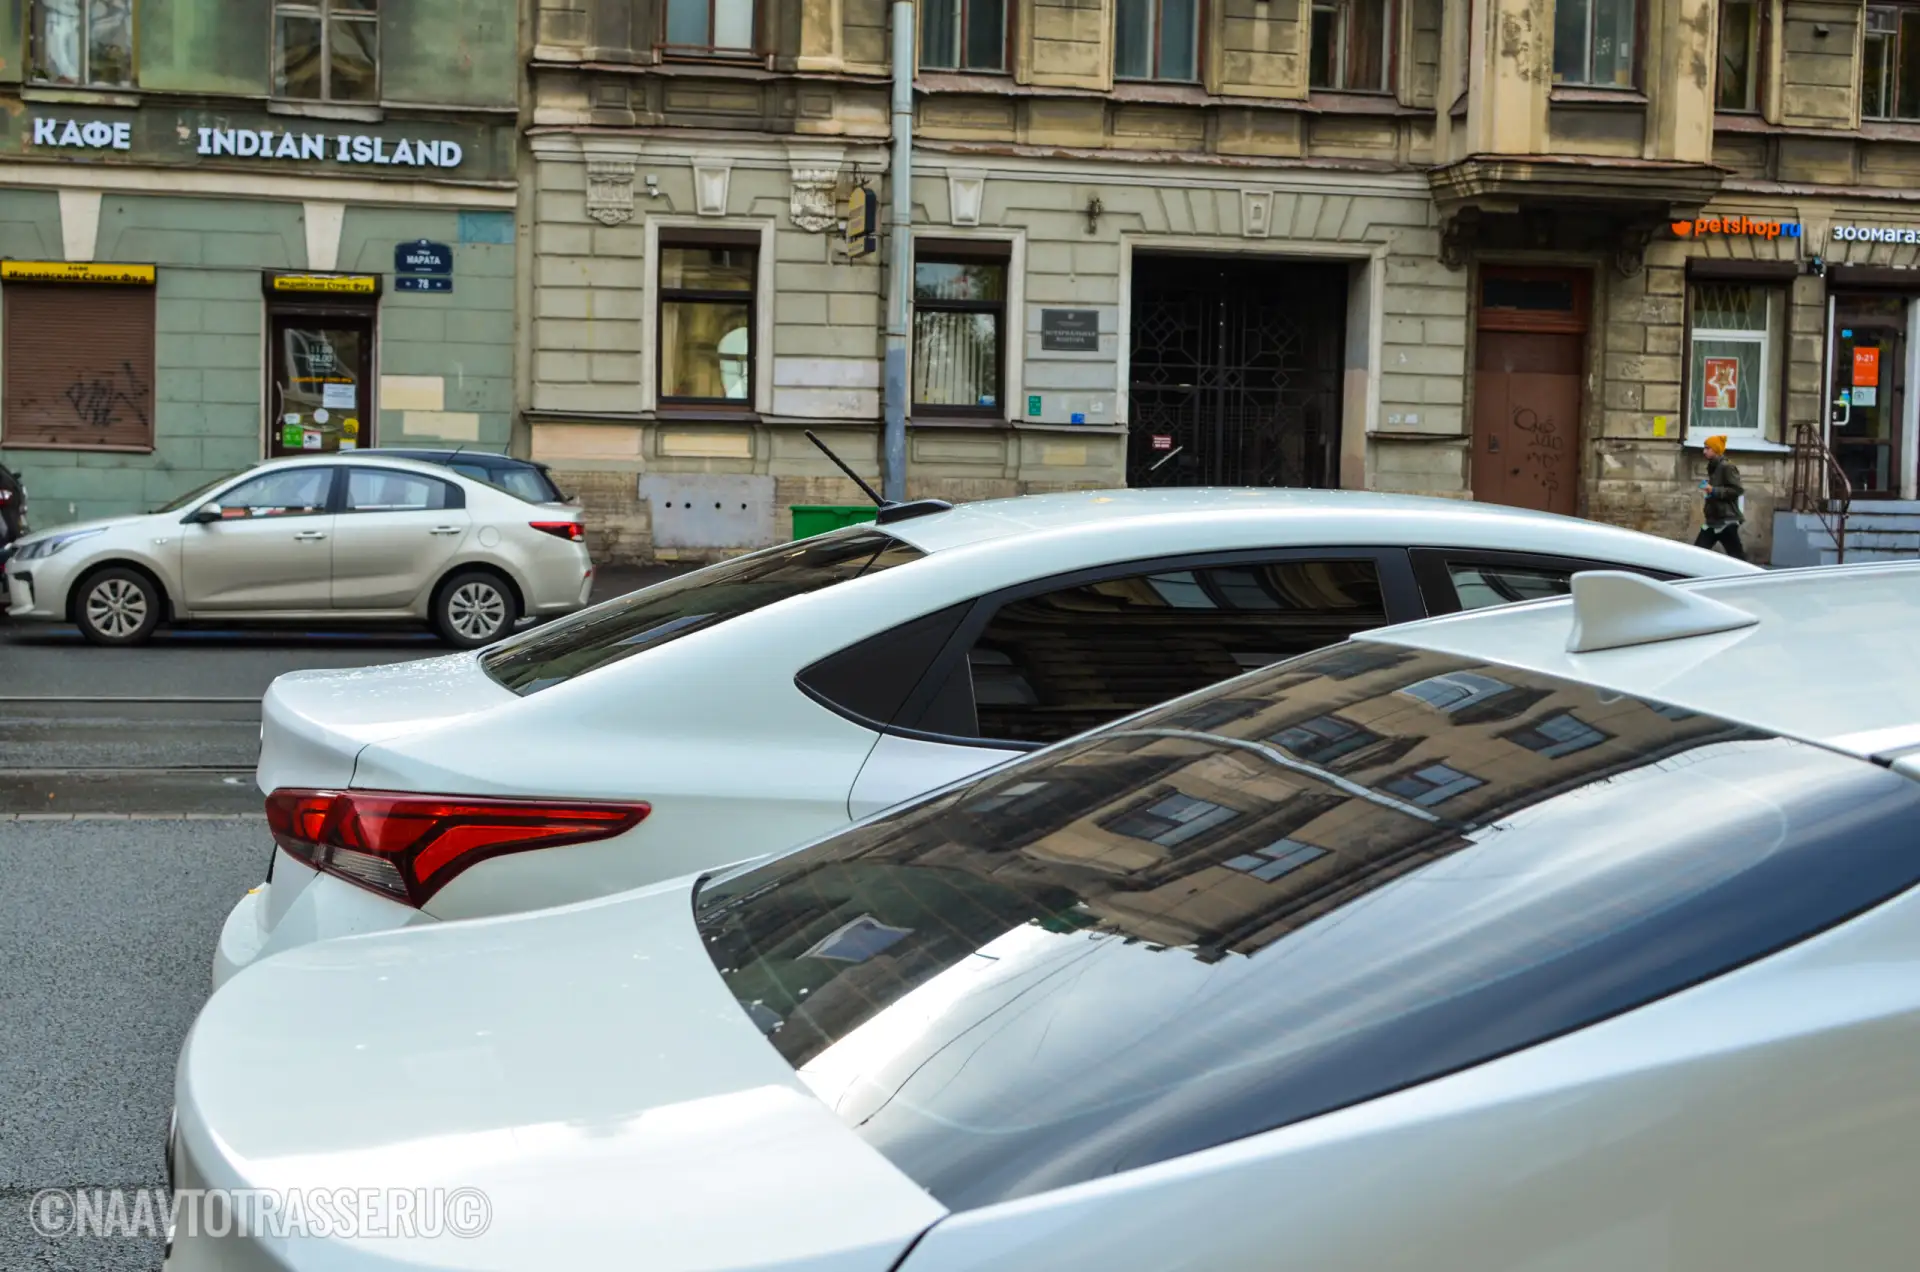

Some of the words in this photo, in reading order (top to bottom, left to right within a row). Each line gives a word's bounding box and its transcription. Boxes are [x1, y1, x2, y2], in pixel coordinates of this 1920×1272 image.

[33, 117, 132, 150] КАФЕ
[197, 127, 325, 160] INDIAN
[336, 135, 463, 168] ISLAND
[406, 255, 442, 265] МАРАТА
[417, 278, 430, 289] 78
